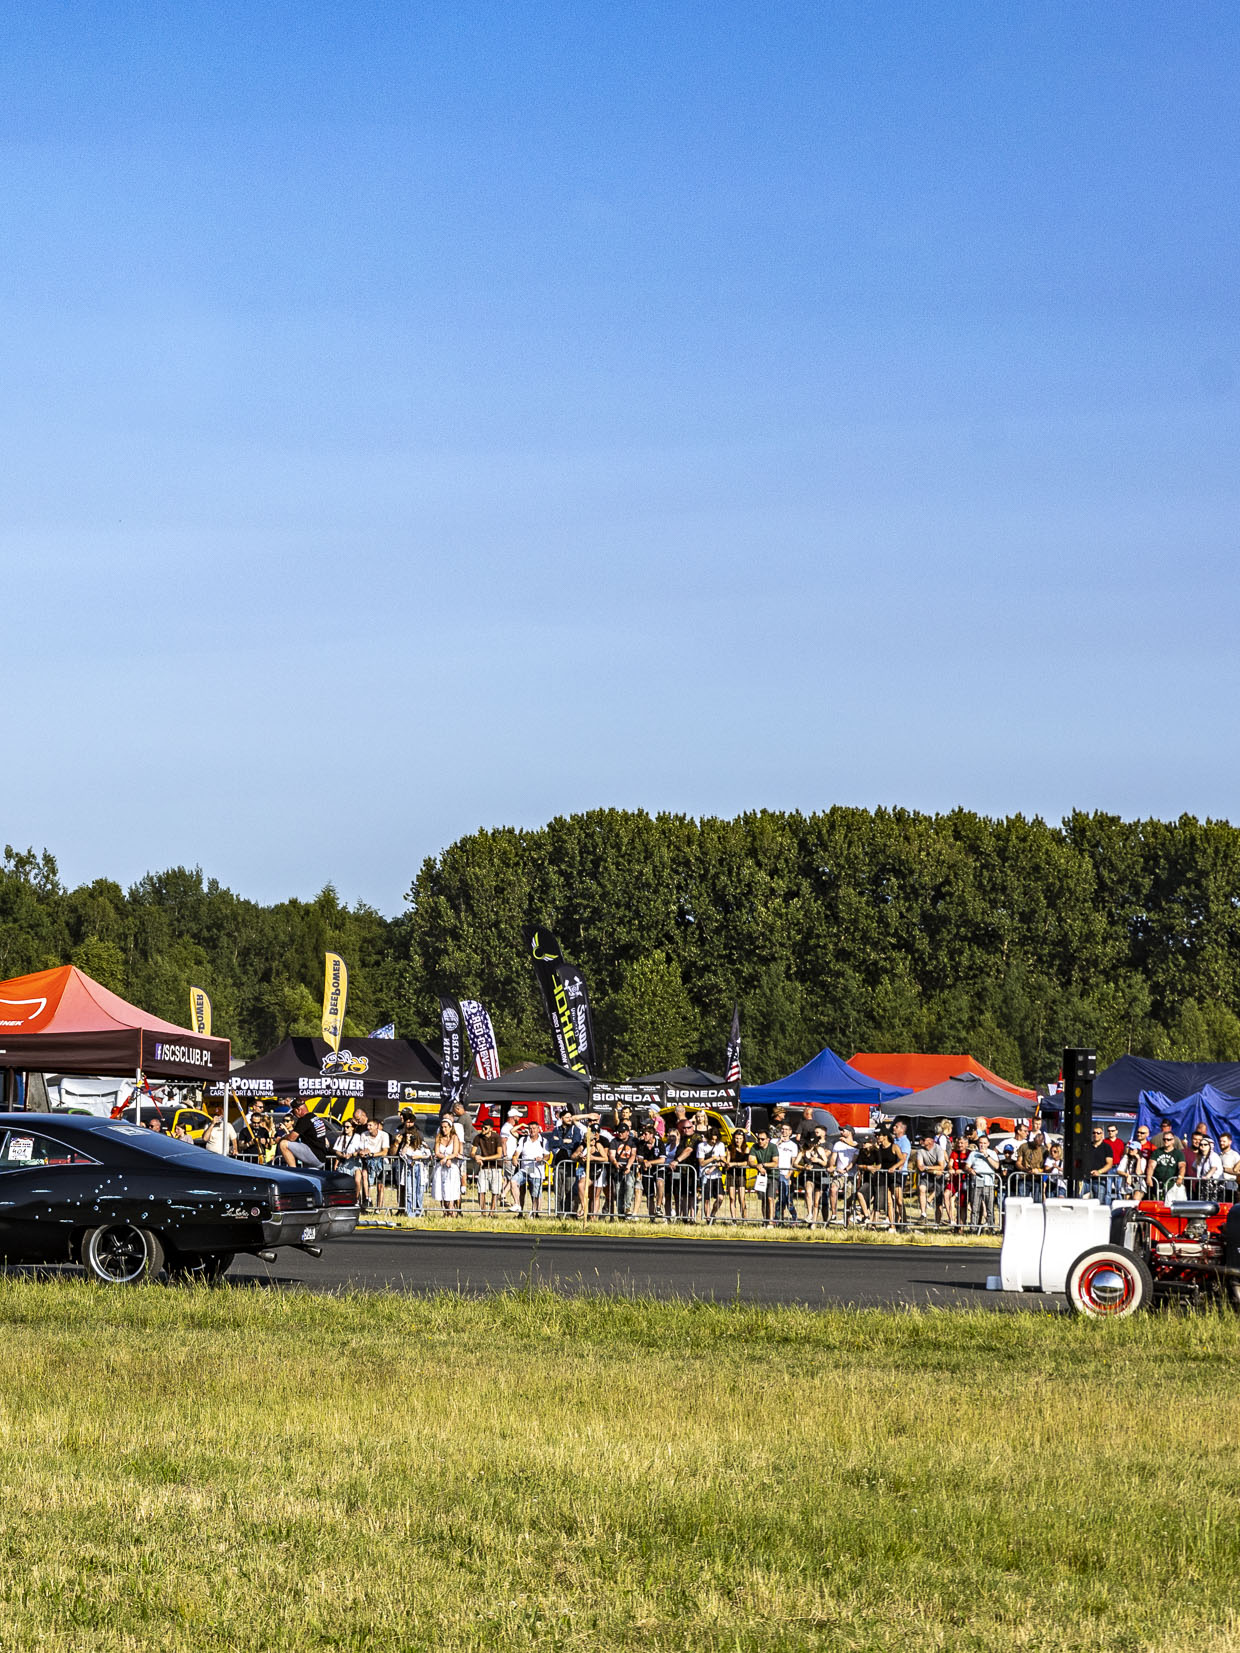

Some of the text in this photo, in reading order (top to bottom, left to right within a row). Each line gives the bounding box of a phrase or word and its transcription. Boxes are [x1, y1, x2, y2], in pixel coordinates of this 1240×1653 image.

[471, 1015, 484, 1036] RED
[593, 1093, 653, 1102] SIGNEDA
[667, 1089, 727, 1098] SIGNEDA
